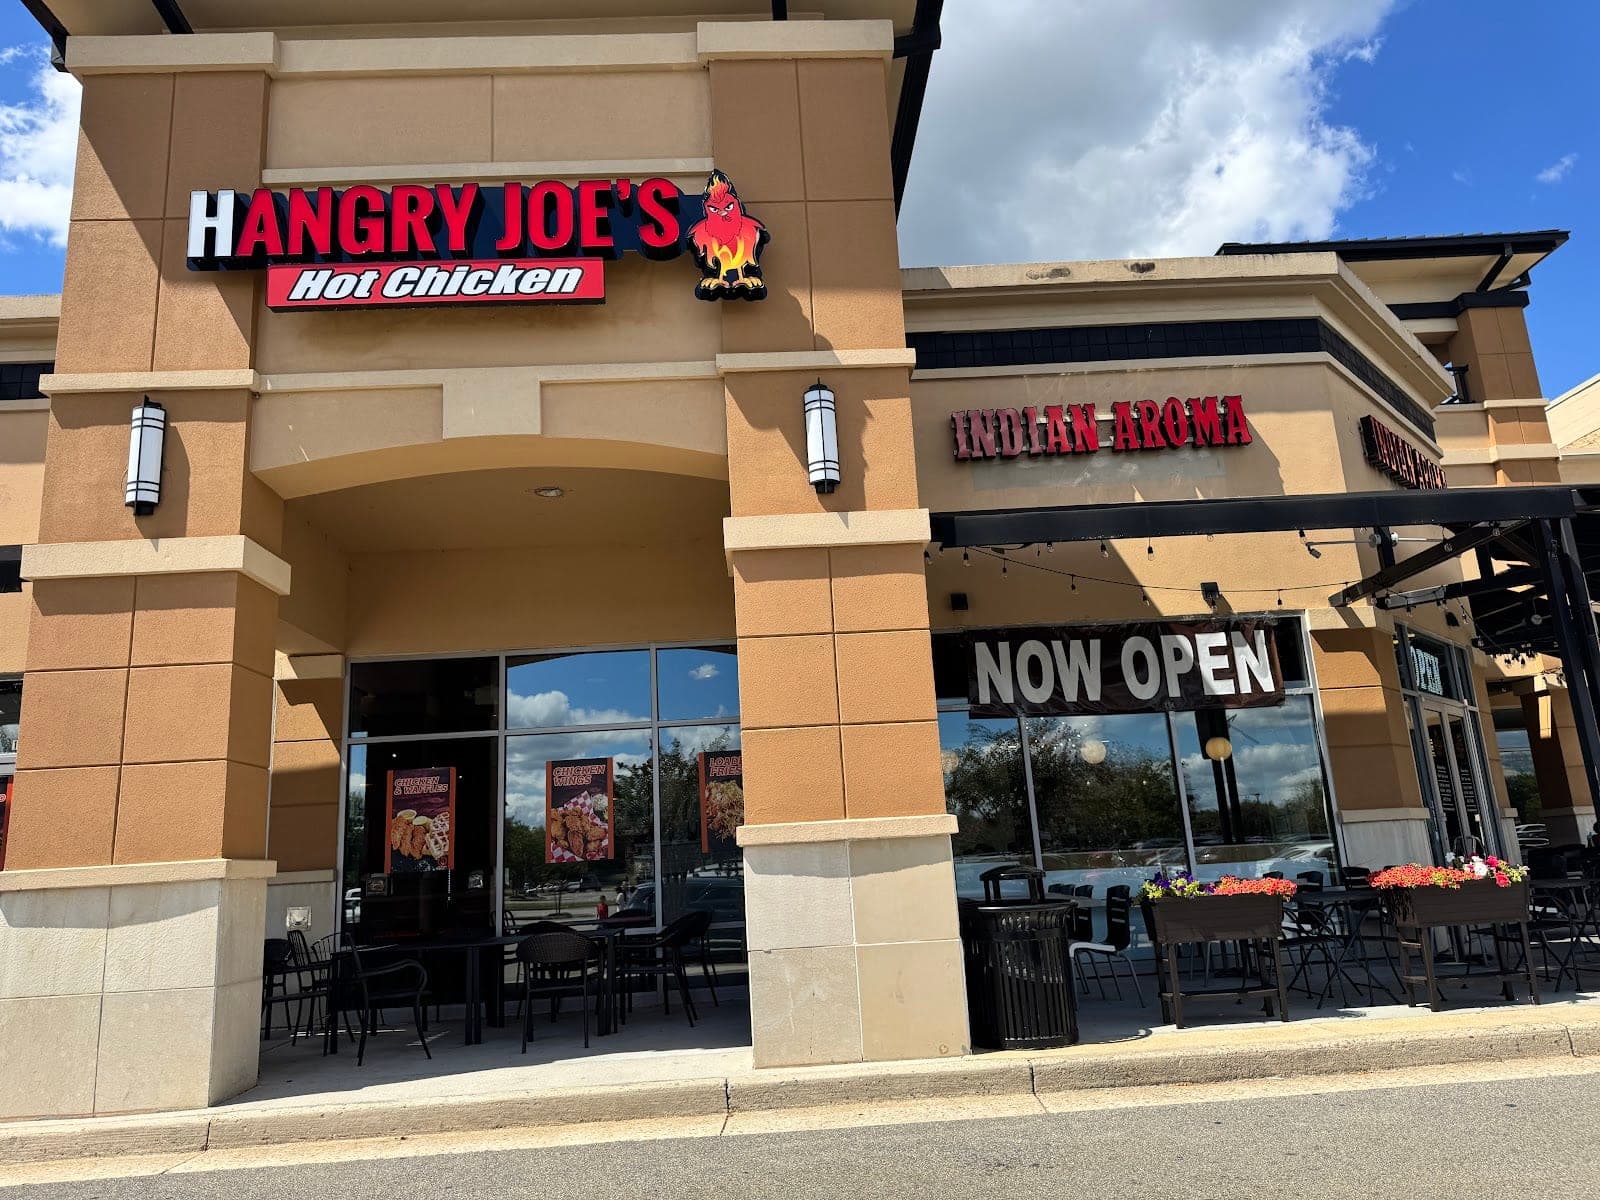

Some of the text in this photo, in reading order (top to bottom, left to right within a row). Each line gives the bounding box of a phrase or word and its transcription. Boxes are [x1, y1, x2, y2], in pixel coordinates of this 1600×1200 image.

[187, 177, 680, 258] HANGRY JOE'S
[289, 262, 583, 302] Hot Chicken
[951, 395, 1253, 460] INDIAN AROMA
[974, 629, 1275, 704] NOW OPEN
[394, 776, 440, 787] CHICKEN
[553, 764, 606, 777] CHICKEN
[554, 775, 592, 787] WINGS
